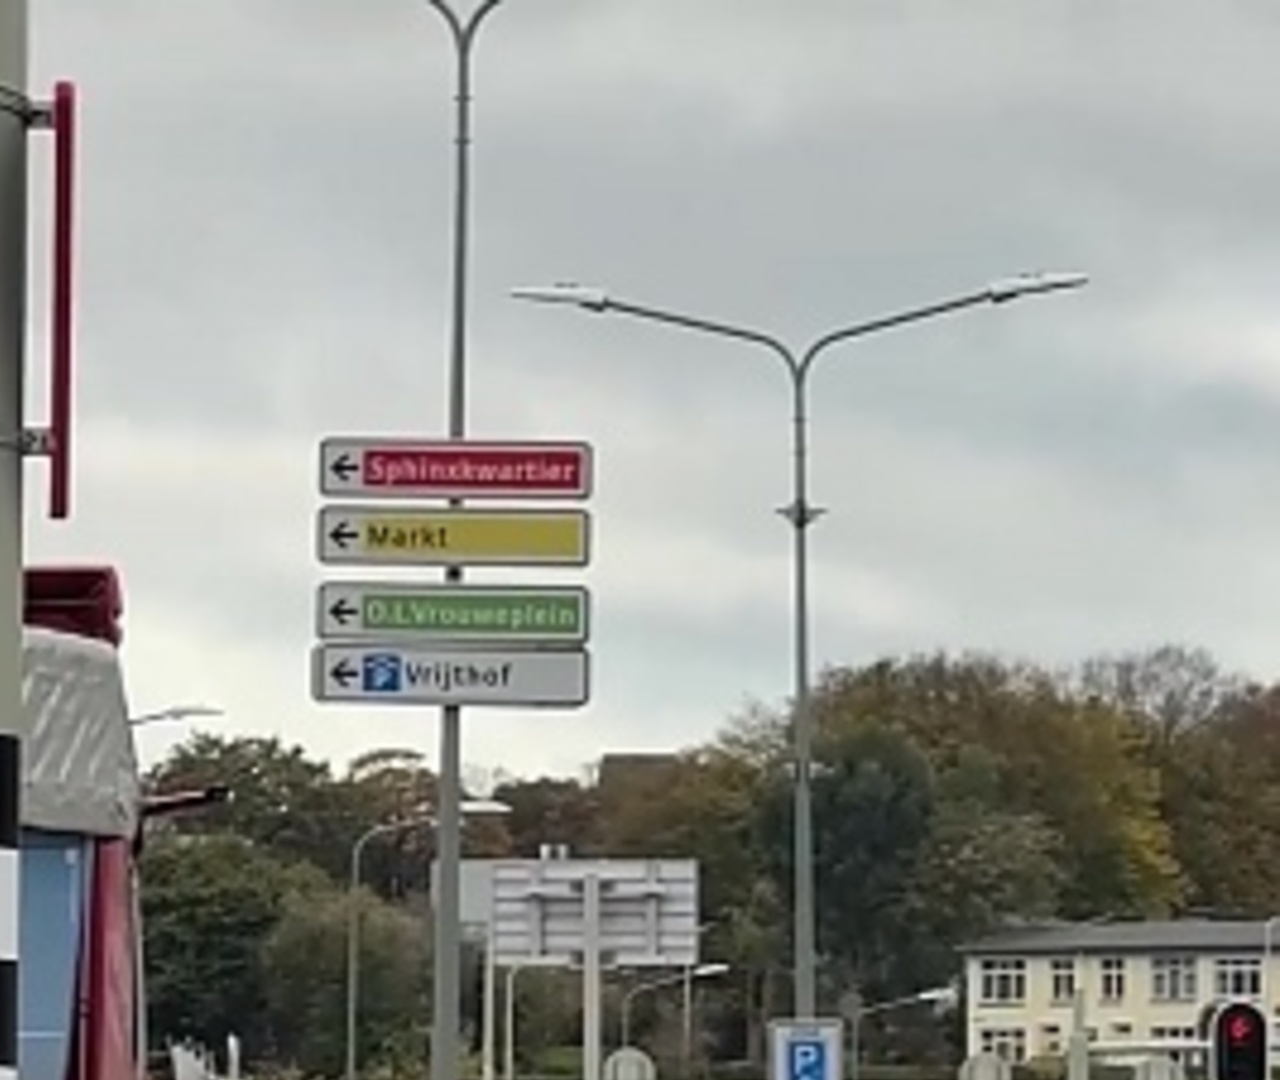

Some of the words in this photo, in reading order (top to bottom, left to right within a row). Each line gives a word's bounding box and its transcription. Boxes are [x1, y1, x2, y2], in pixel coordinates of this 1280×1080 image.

[369, 455, 576, 484] Sphinxkwartier
[367, 525, 448, 549] Markt
[406, 661, 513, 691] Vrijthof
